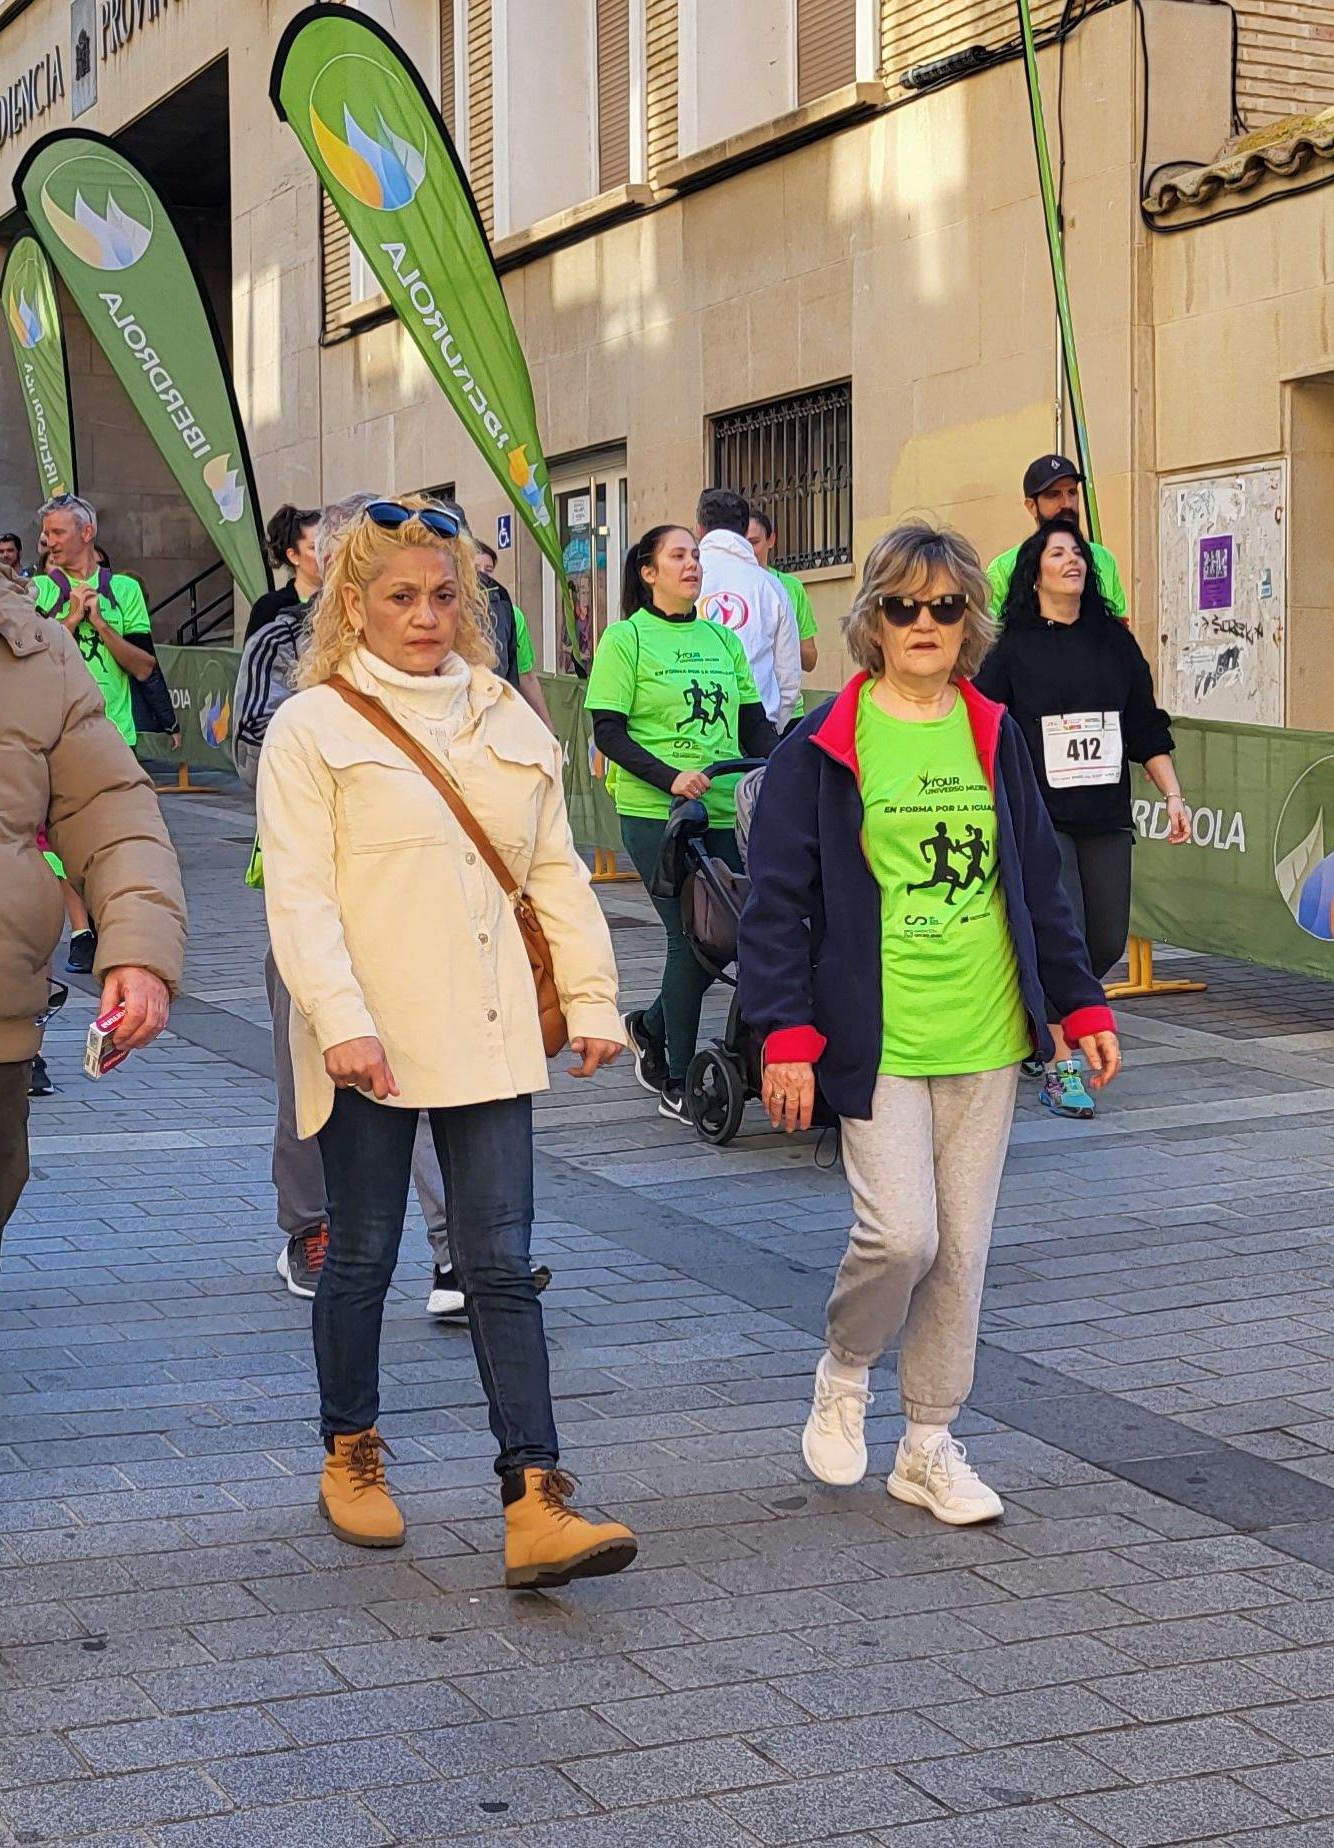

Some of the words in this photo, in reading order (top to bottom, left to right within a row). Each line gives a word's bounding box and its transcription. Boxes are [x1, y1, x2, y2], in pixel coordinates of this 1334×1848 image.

[168, 688, 192, 710] OLA
[1067, 737, 1102, 761] 412
[925, 785, 964, 795] UNIVERSO
[884, 805, 896, 813] EN
[900, 805, 933, 813] FORMA
[935, 804, 955, 812] POR
[1131, 799, 1245, 853] RDOLA
